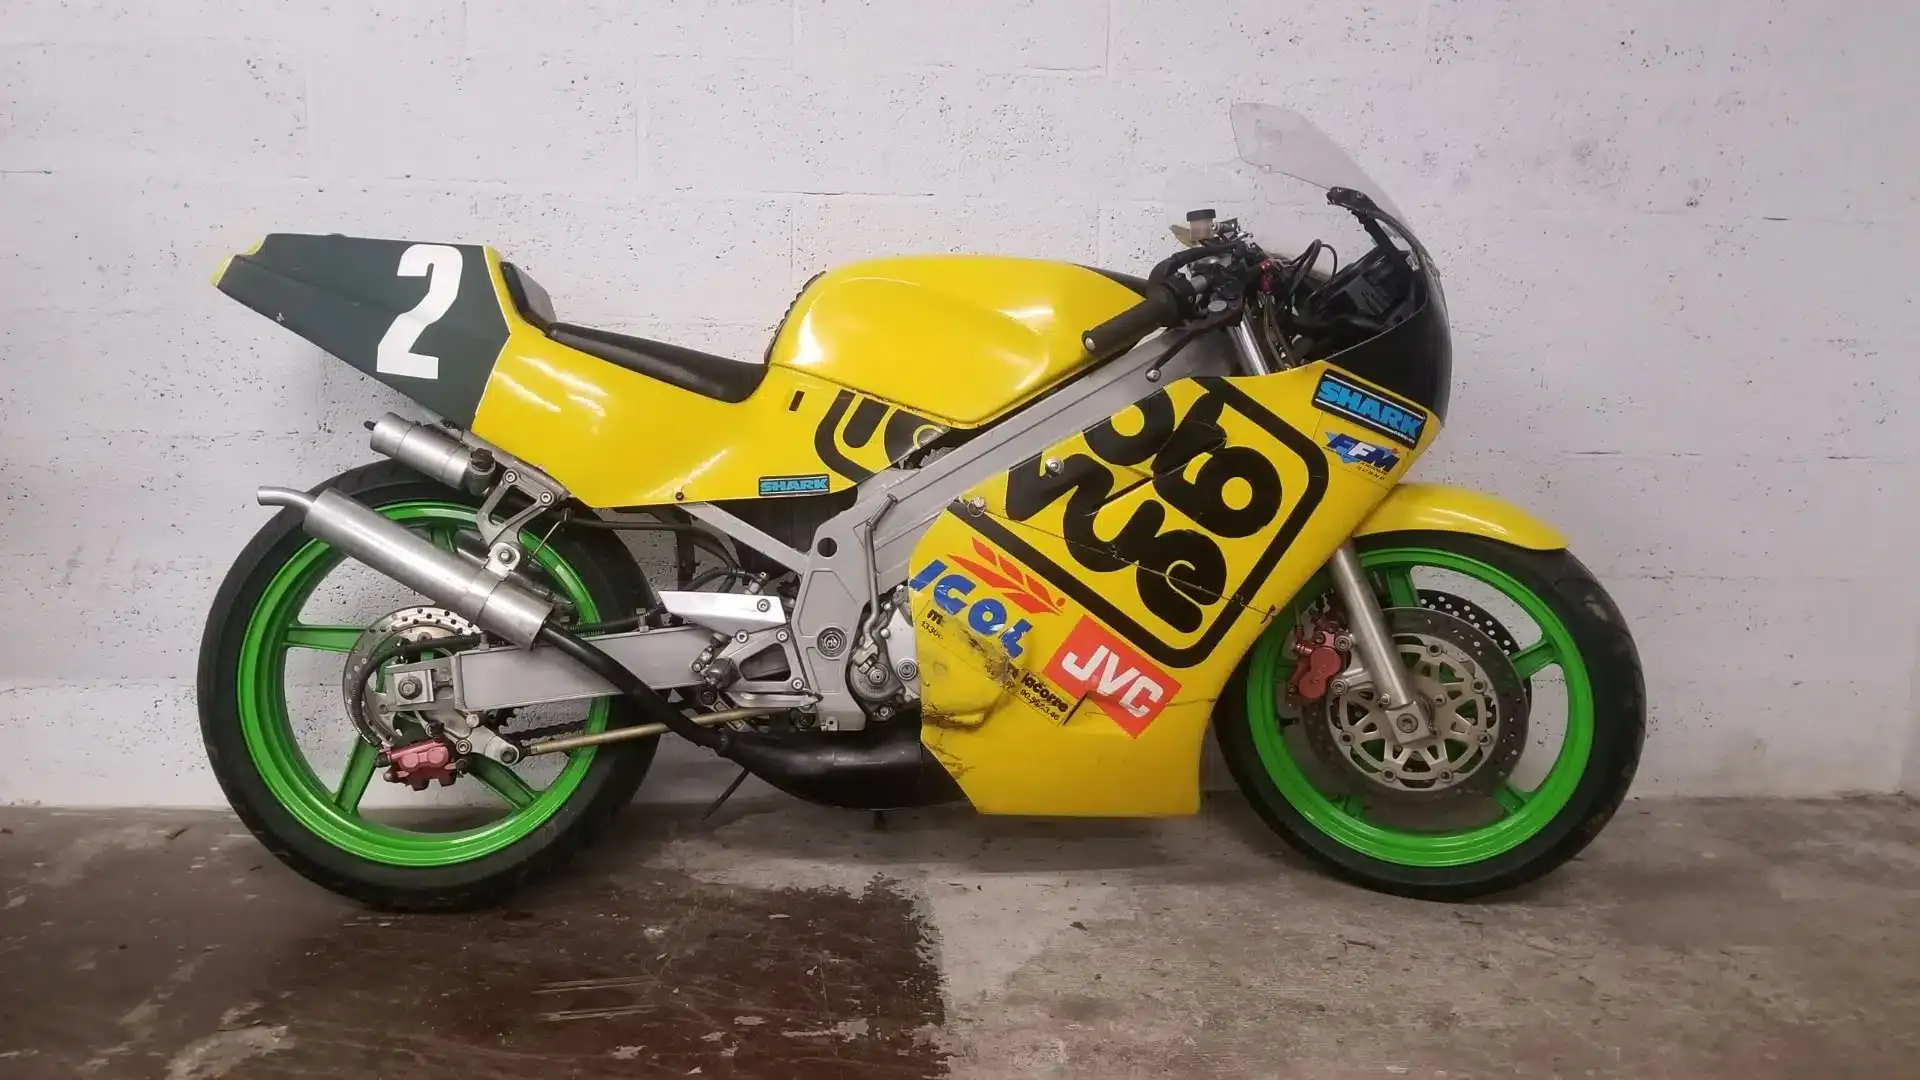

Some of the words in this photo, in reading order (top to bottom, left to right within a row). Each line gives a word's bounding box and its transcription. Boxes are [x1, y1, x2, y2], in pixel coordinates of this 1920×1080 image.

[376, 243, 463, 380] 2
[1318, 379, 1425, 440] SHARK
[760, 478, 828, 492] SHARK
[1061, 645, 1165, 718] JVC
